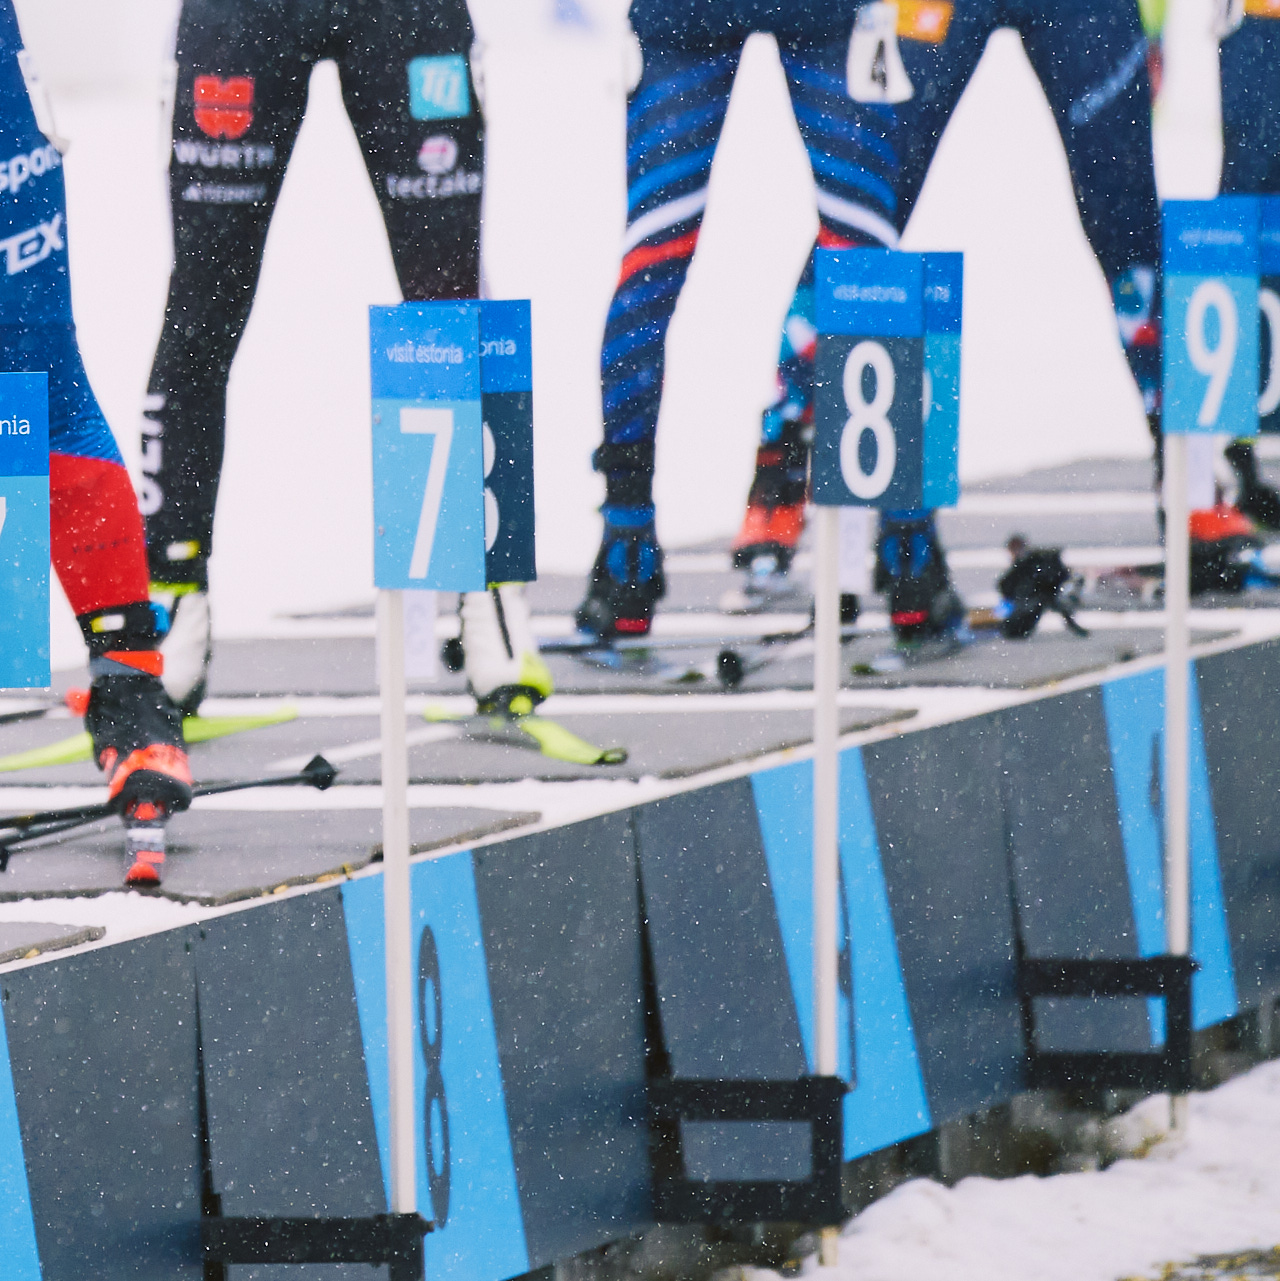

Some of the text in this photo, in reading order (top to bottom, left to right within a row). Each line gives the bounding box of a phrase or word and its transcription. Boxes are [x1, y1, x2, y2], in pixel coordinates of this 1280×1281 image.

[386, 343, 463, 364] visit estonia
[841, 341, 897, 500] 8
[1186, 281, 1238, 427] 9
[400, 408, 454, 580] 7
